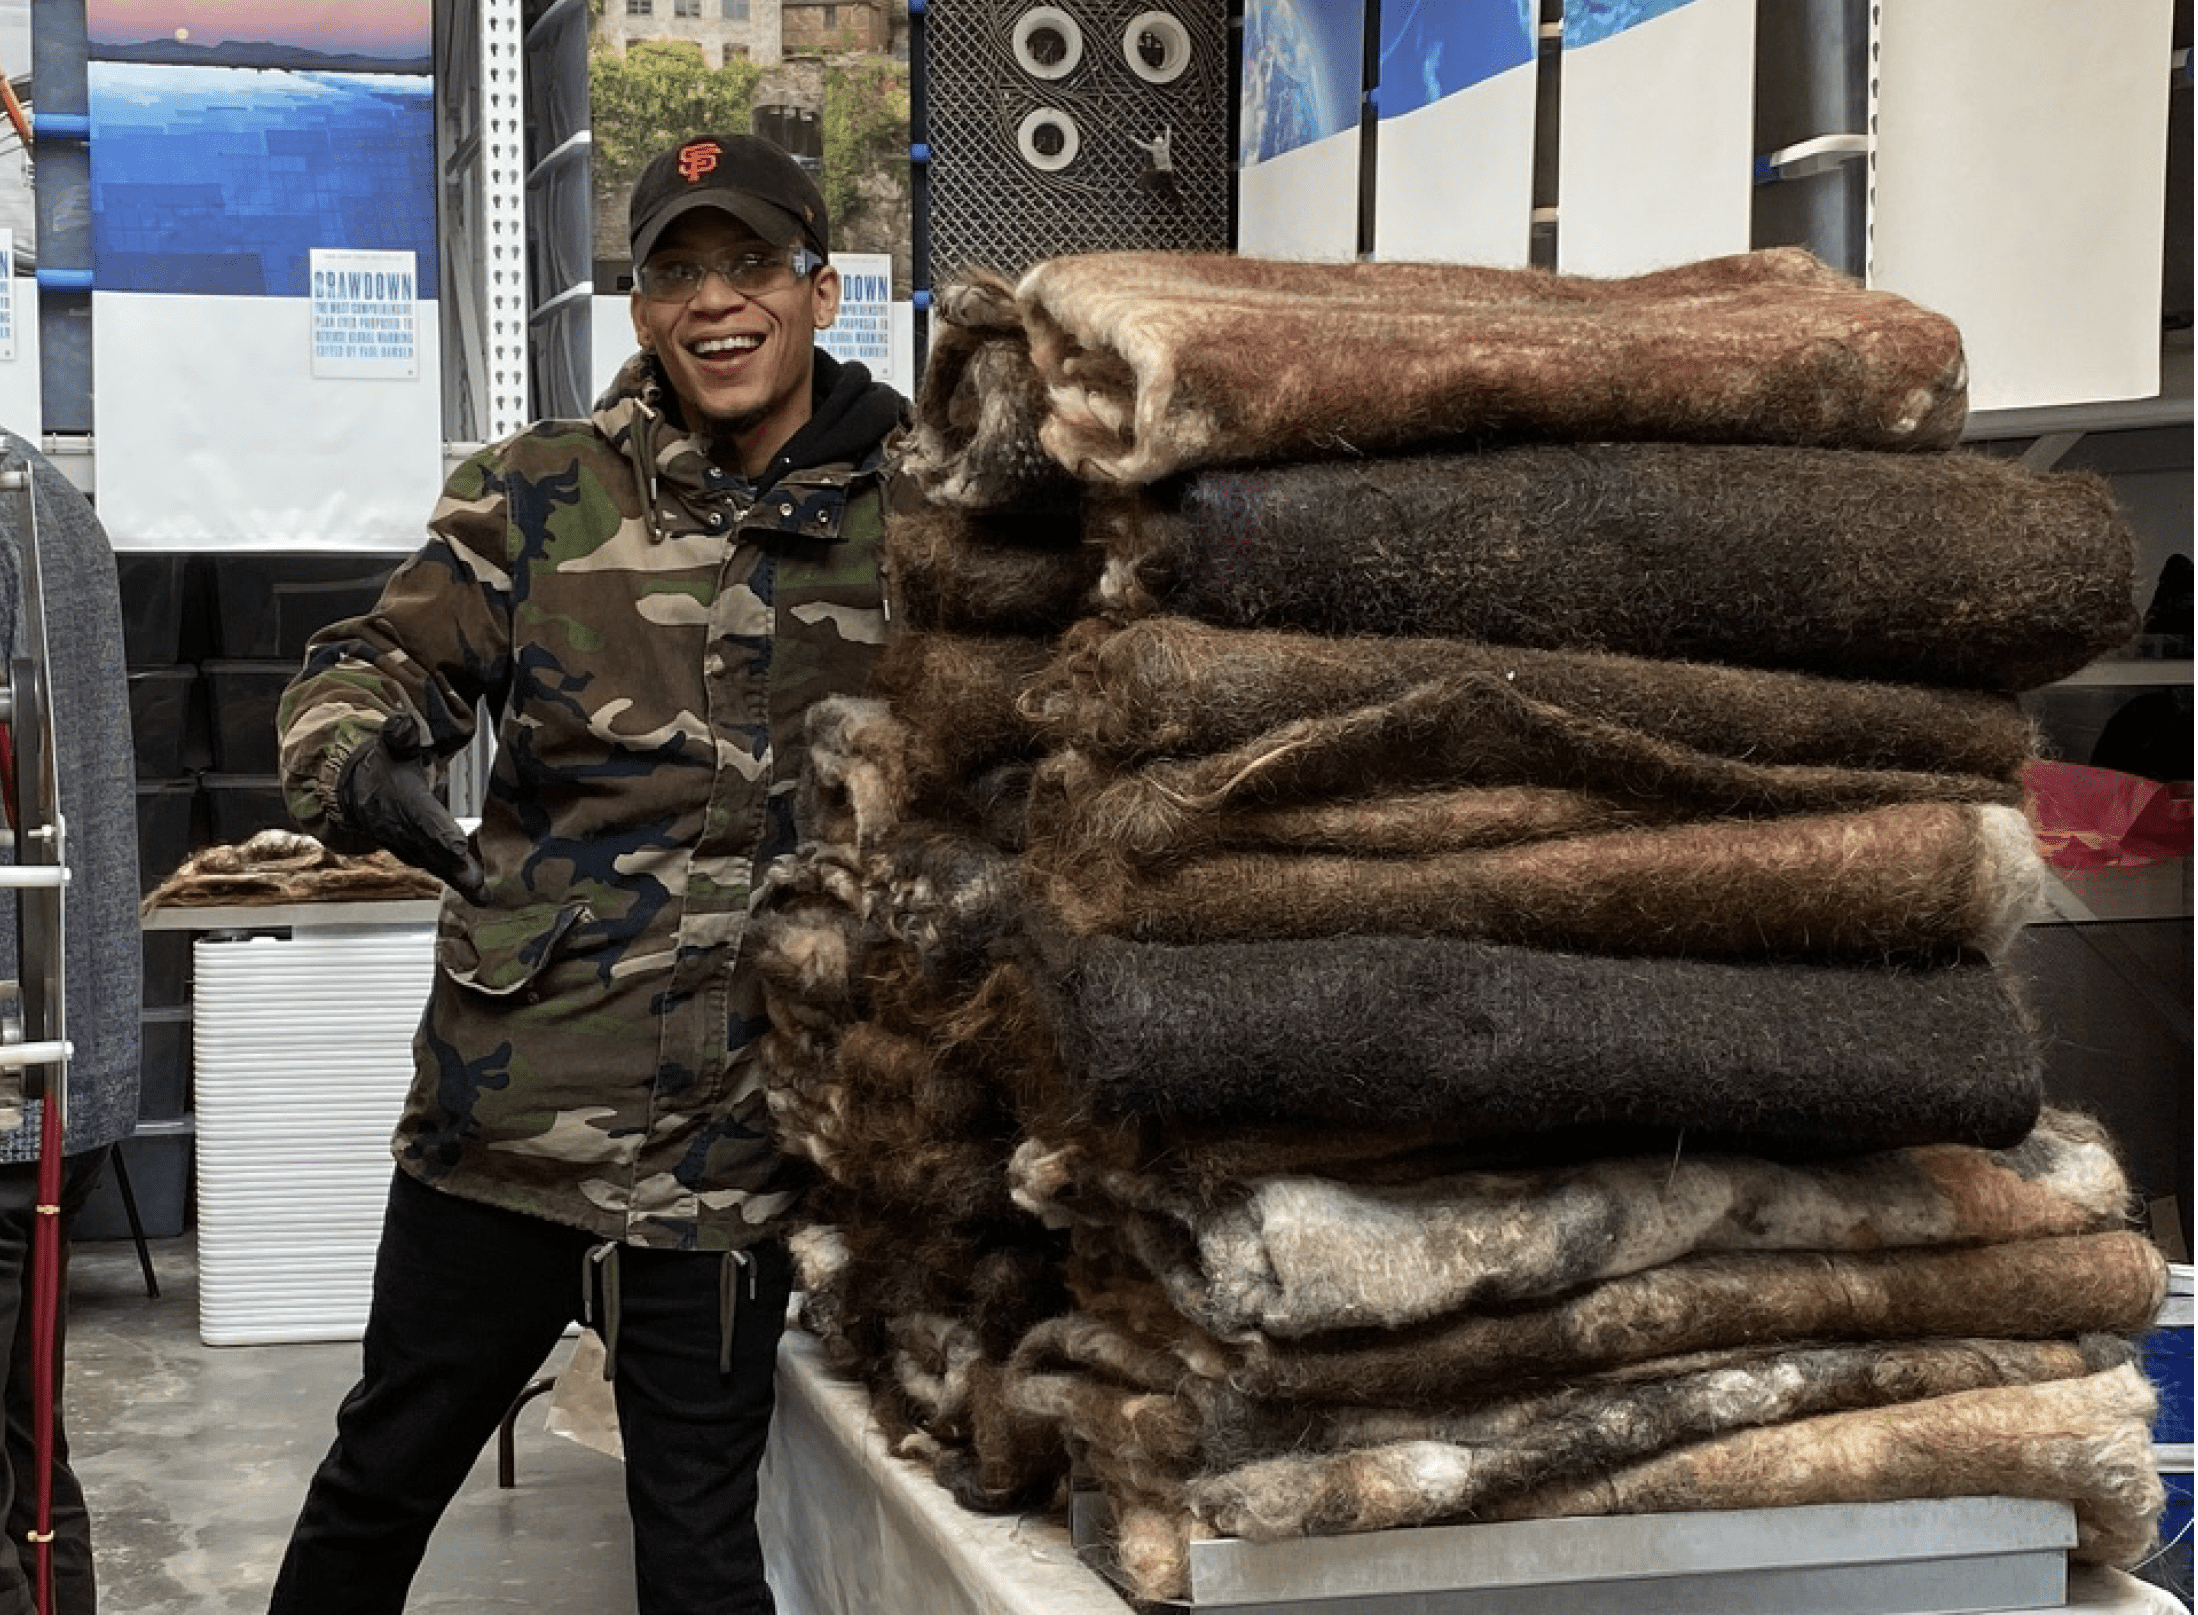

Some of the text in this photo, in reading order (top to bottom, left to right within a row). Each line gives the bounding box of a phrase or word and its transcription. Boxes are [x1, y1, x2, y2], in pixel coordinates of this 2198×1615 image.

[677, 142, 724, 183] SF
[314, 271, 412, 301] DRAWDOWN
[843, 274, 888, 302] DOWN
